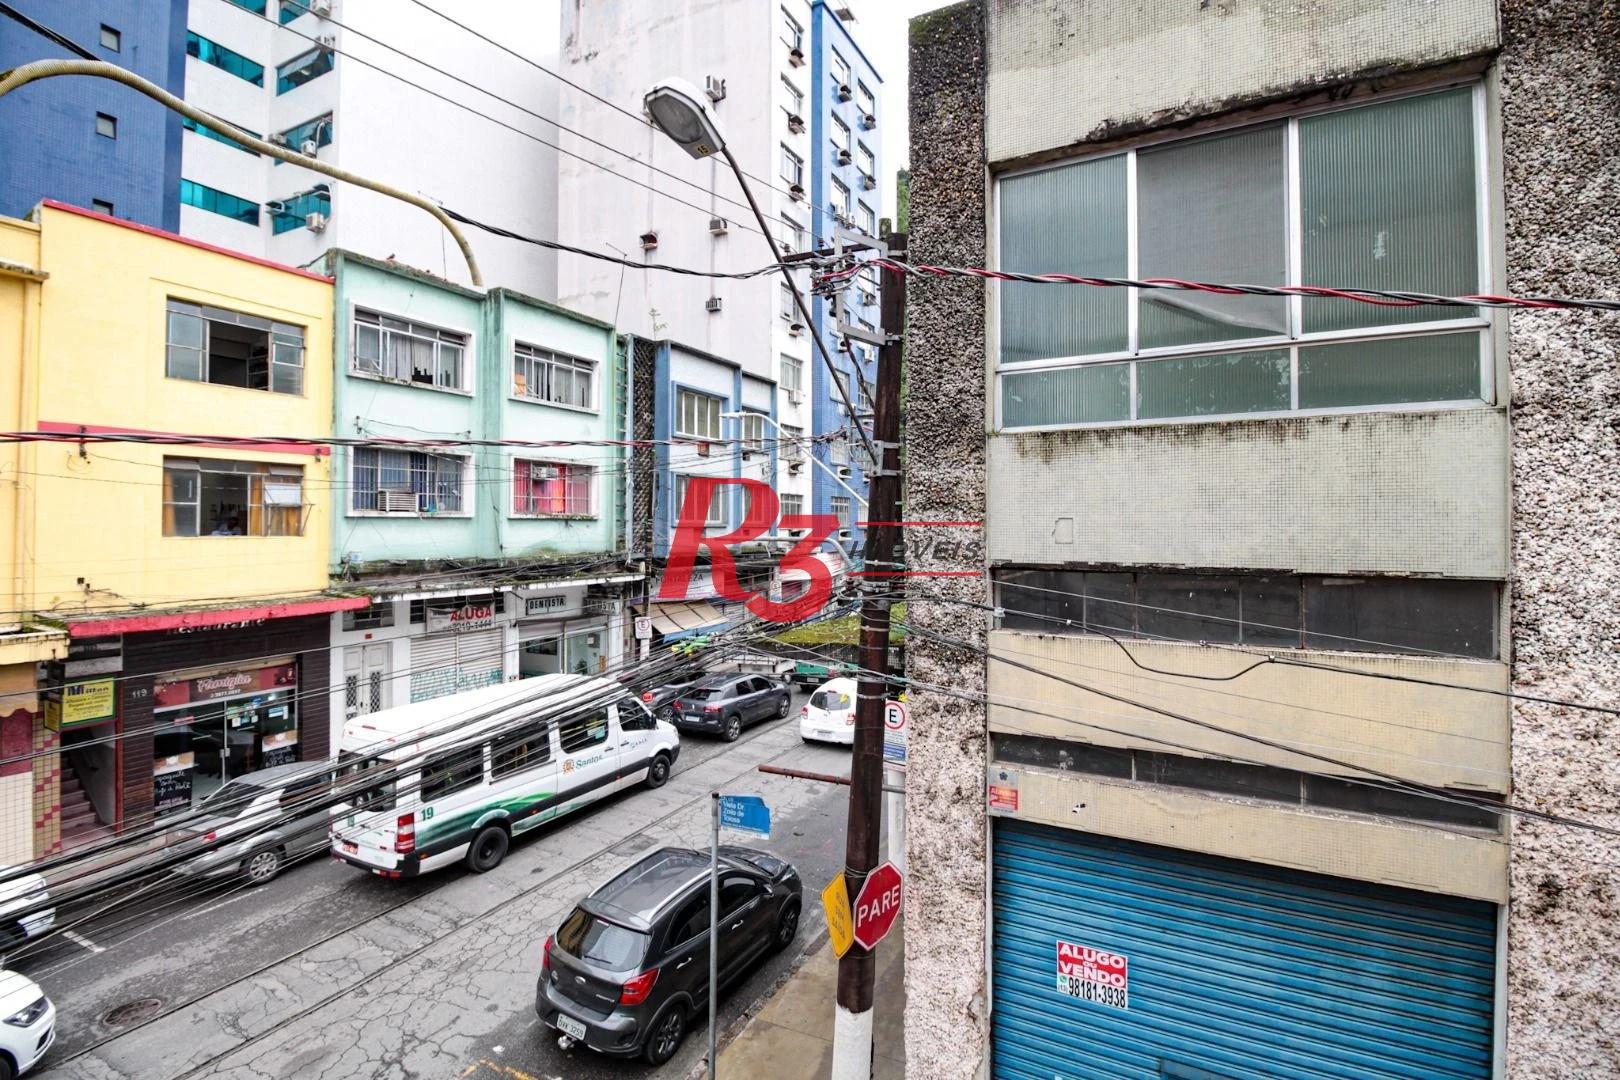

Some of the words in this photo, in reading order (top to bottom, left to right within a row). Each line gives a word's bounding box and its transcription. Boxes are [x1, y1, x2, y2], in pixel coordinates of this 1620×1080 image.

[655, 573, 704, 584] FORTALEZA
[529, 597, 565, 610] DENTISTA
[450, 606, 492, 622] ALUGA
[132, 688, 148, 699] 119
[889, 708, 898, 724] E
[575, 754, 604, 770] Santos
[421, 806, 434, 821] 19
[857, 884, 900, 928] PARE
[1059, 944, 1125, 969] ALUGO
[1059, 960, 1125, 987] VENDO
[1068, 976, 1126, 1008] 98181-3938
